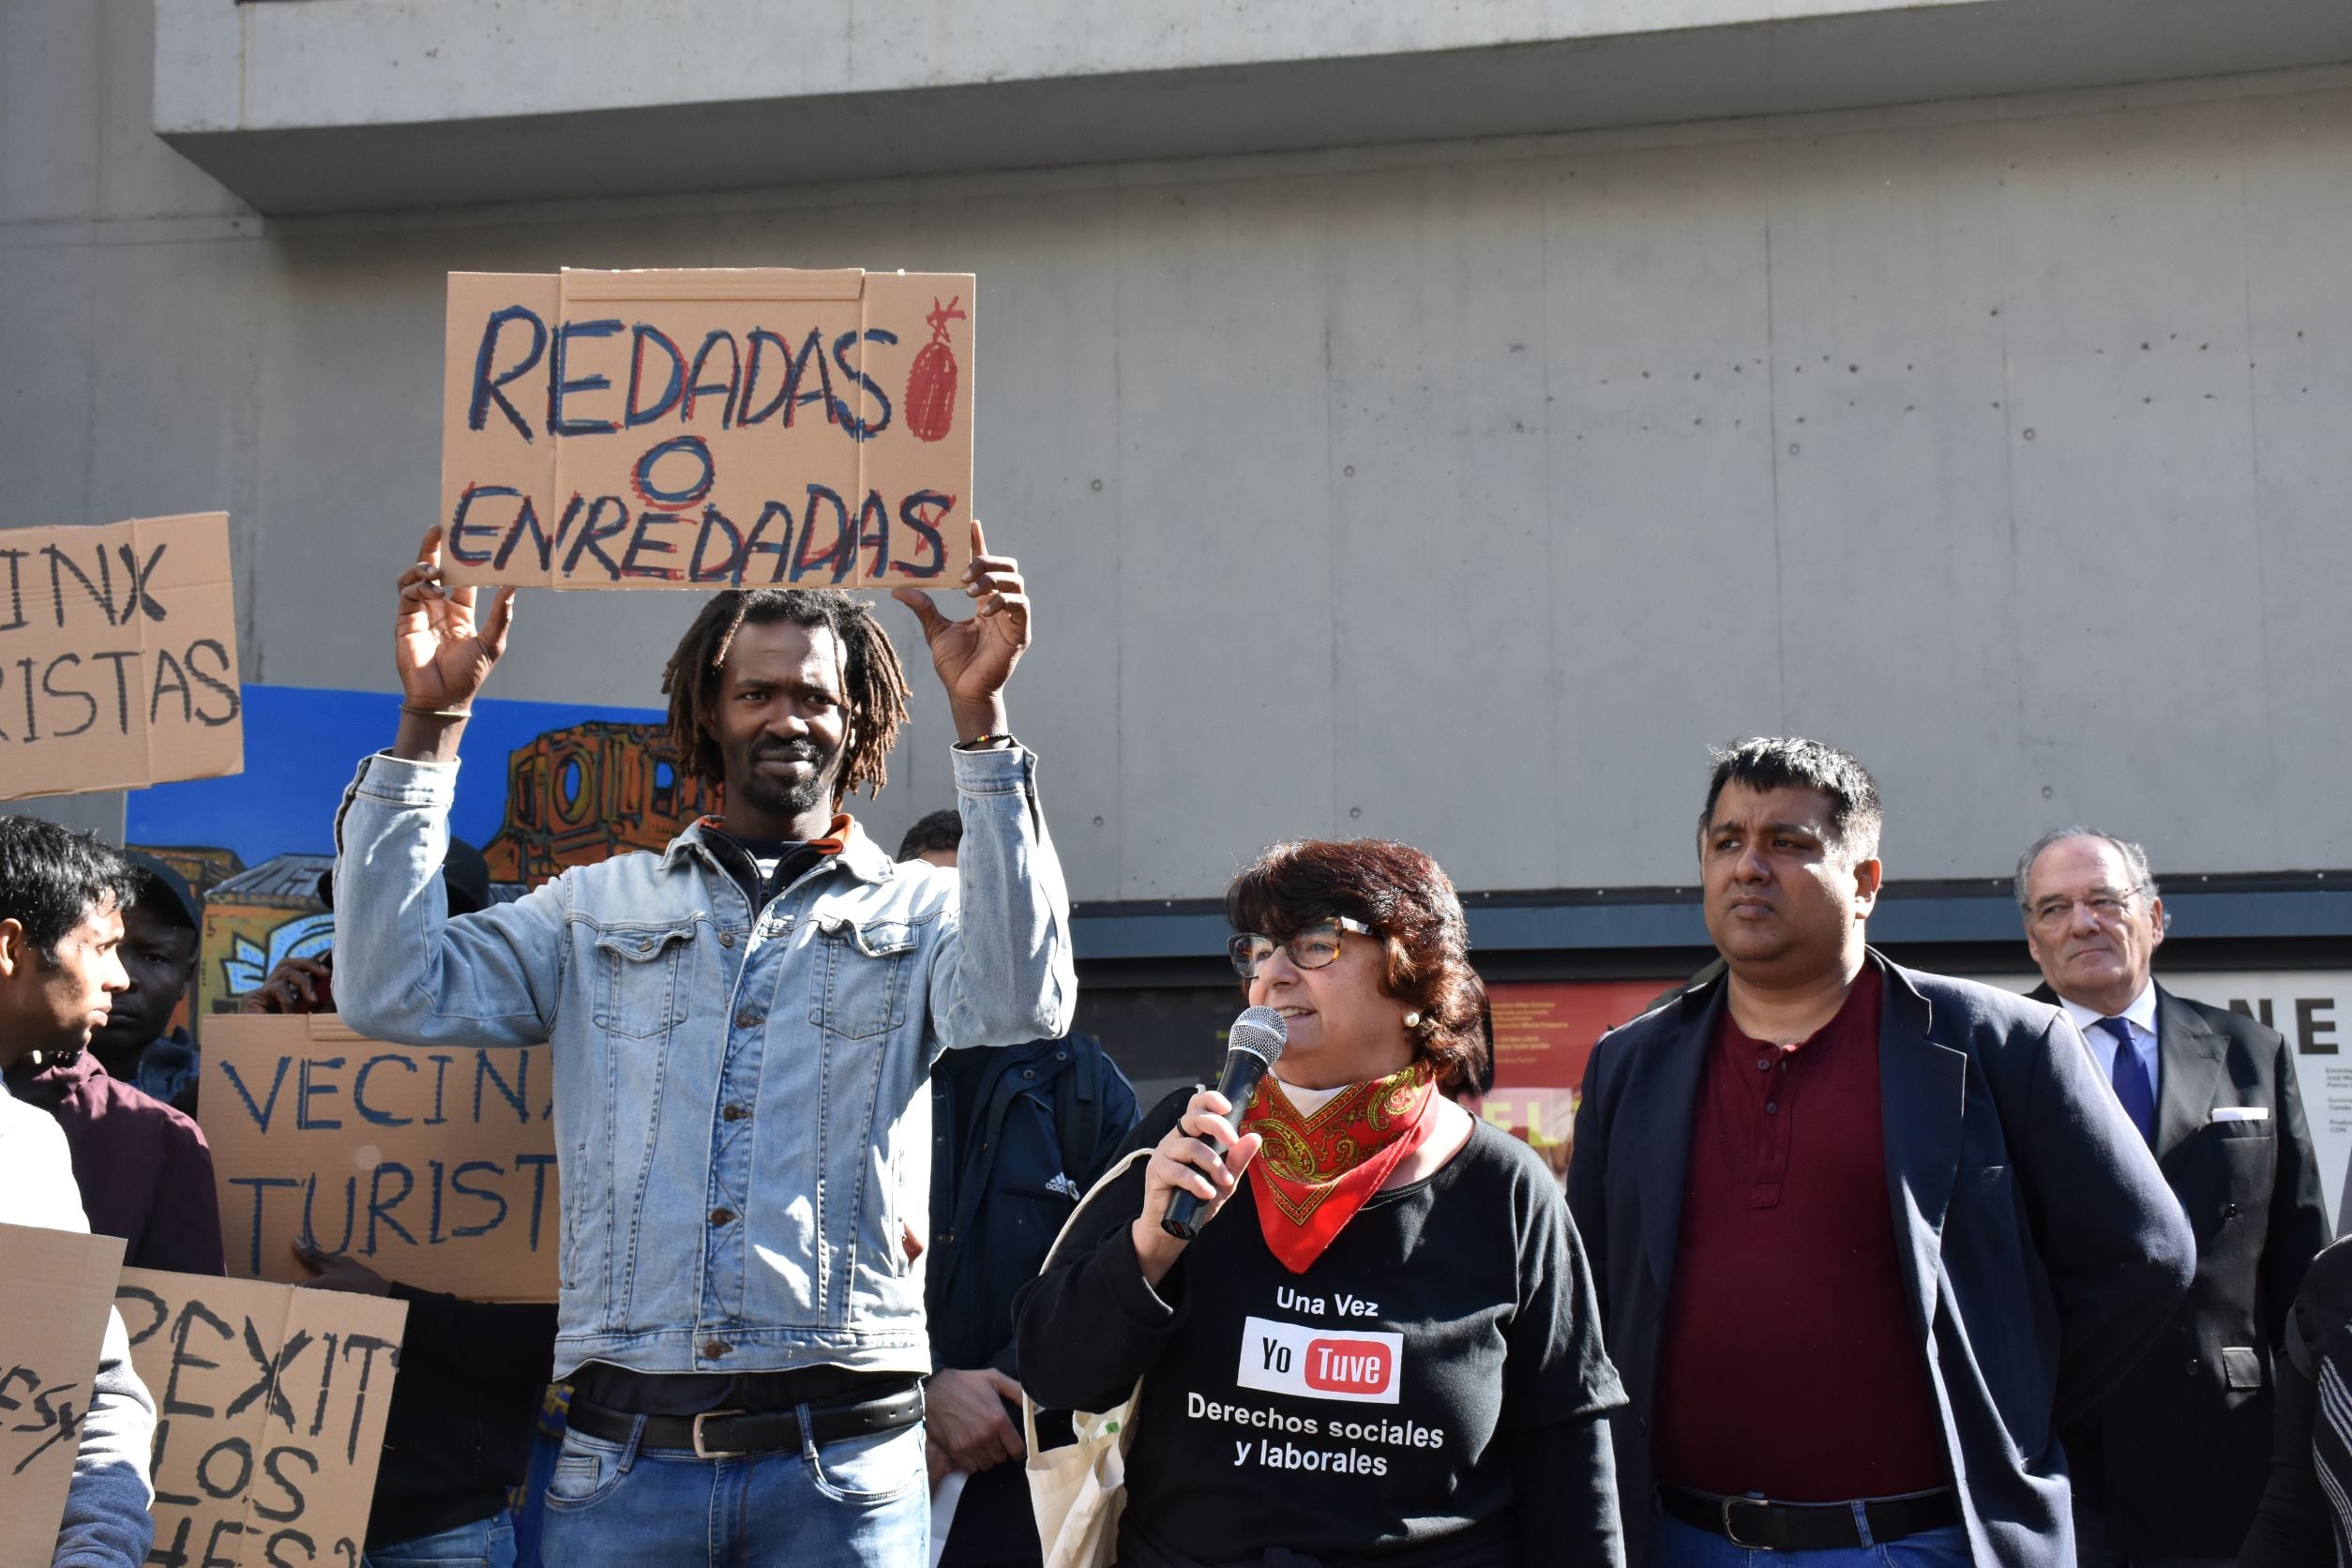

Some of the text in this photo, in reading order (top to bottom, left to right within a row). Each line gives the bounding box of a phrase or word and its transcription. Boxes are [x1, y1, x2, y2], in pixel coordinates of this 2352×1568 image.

[468, 304, 898, 443] REDADAS
[630, 434, 715, 511] O
[448, 481, 957, 587] ENREDADAS
[0, 639, 240, 744] ISTAS
[219, 1048, 553, 1135] VECIN
[1276, 1286, 1379, 1317] Una Vez
[1262, 1336, 1380, 1384] Yo Tuve
[1188, 1392, 1444, 1449] Derechos sociales
[1233, 1439, 1388, 1477] y laborales
